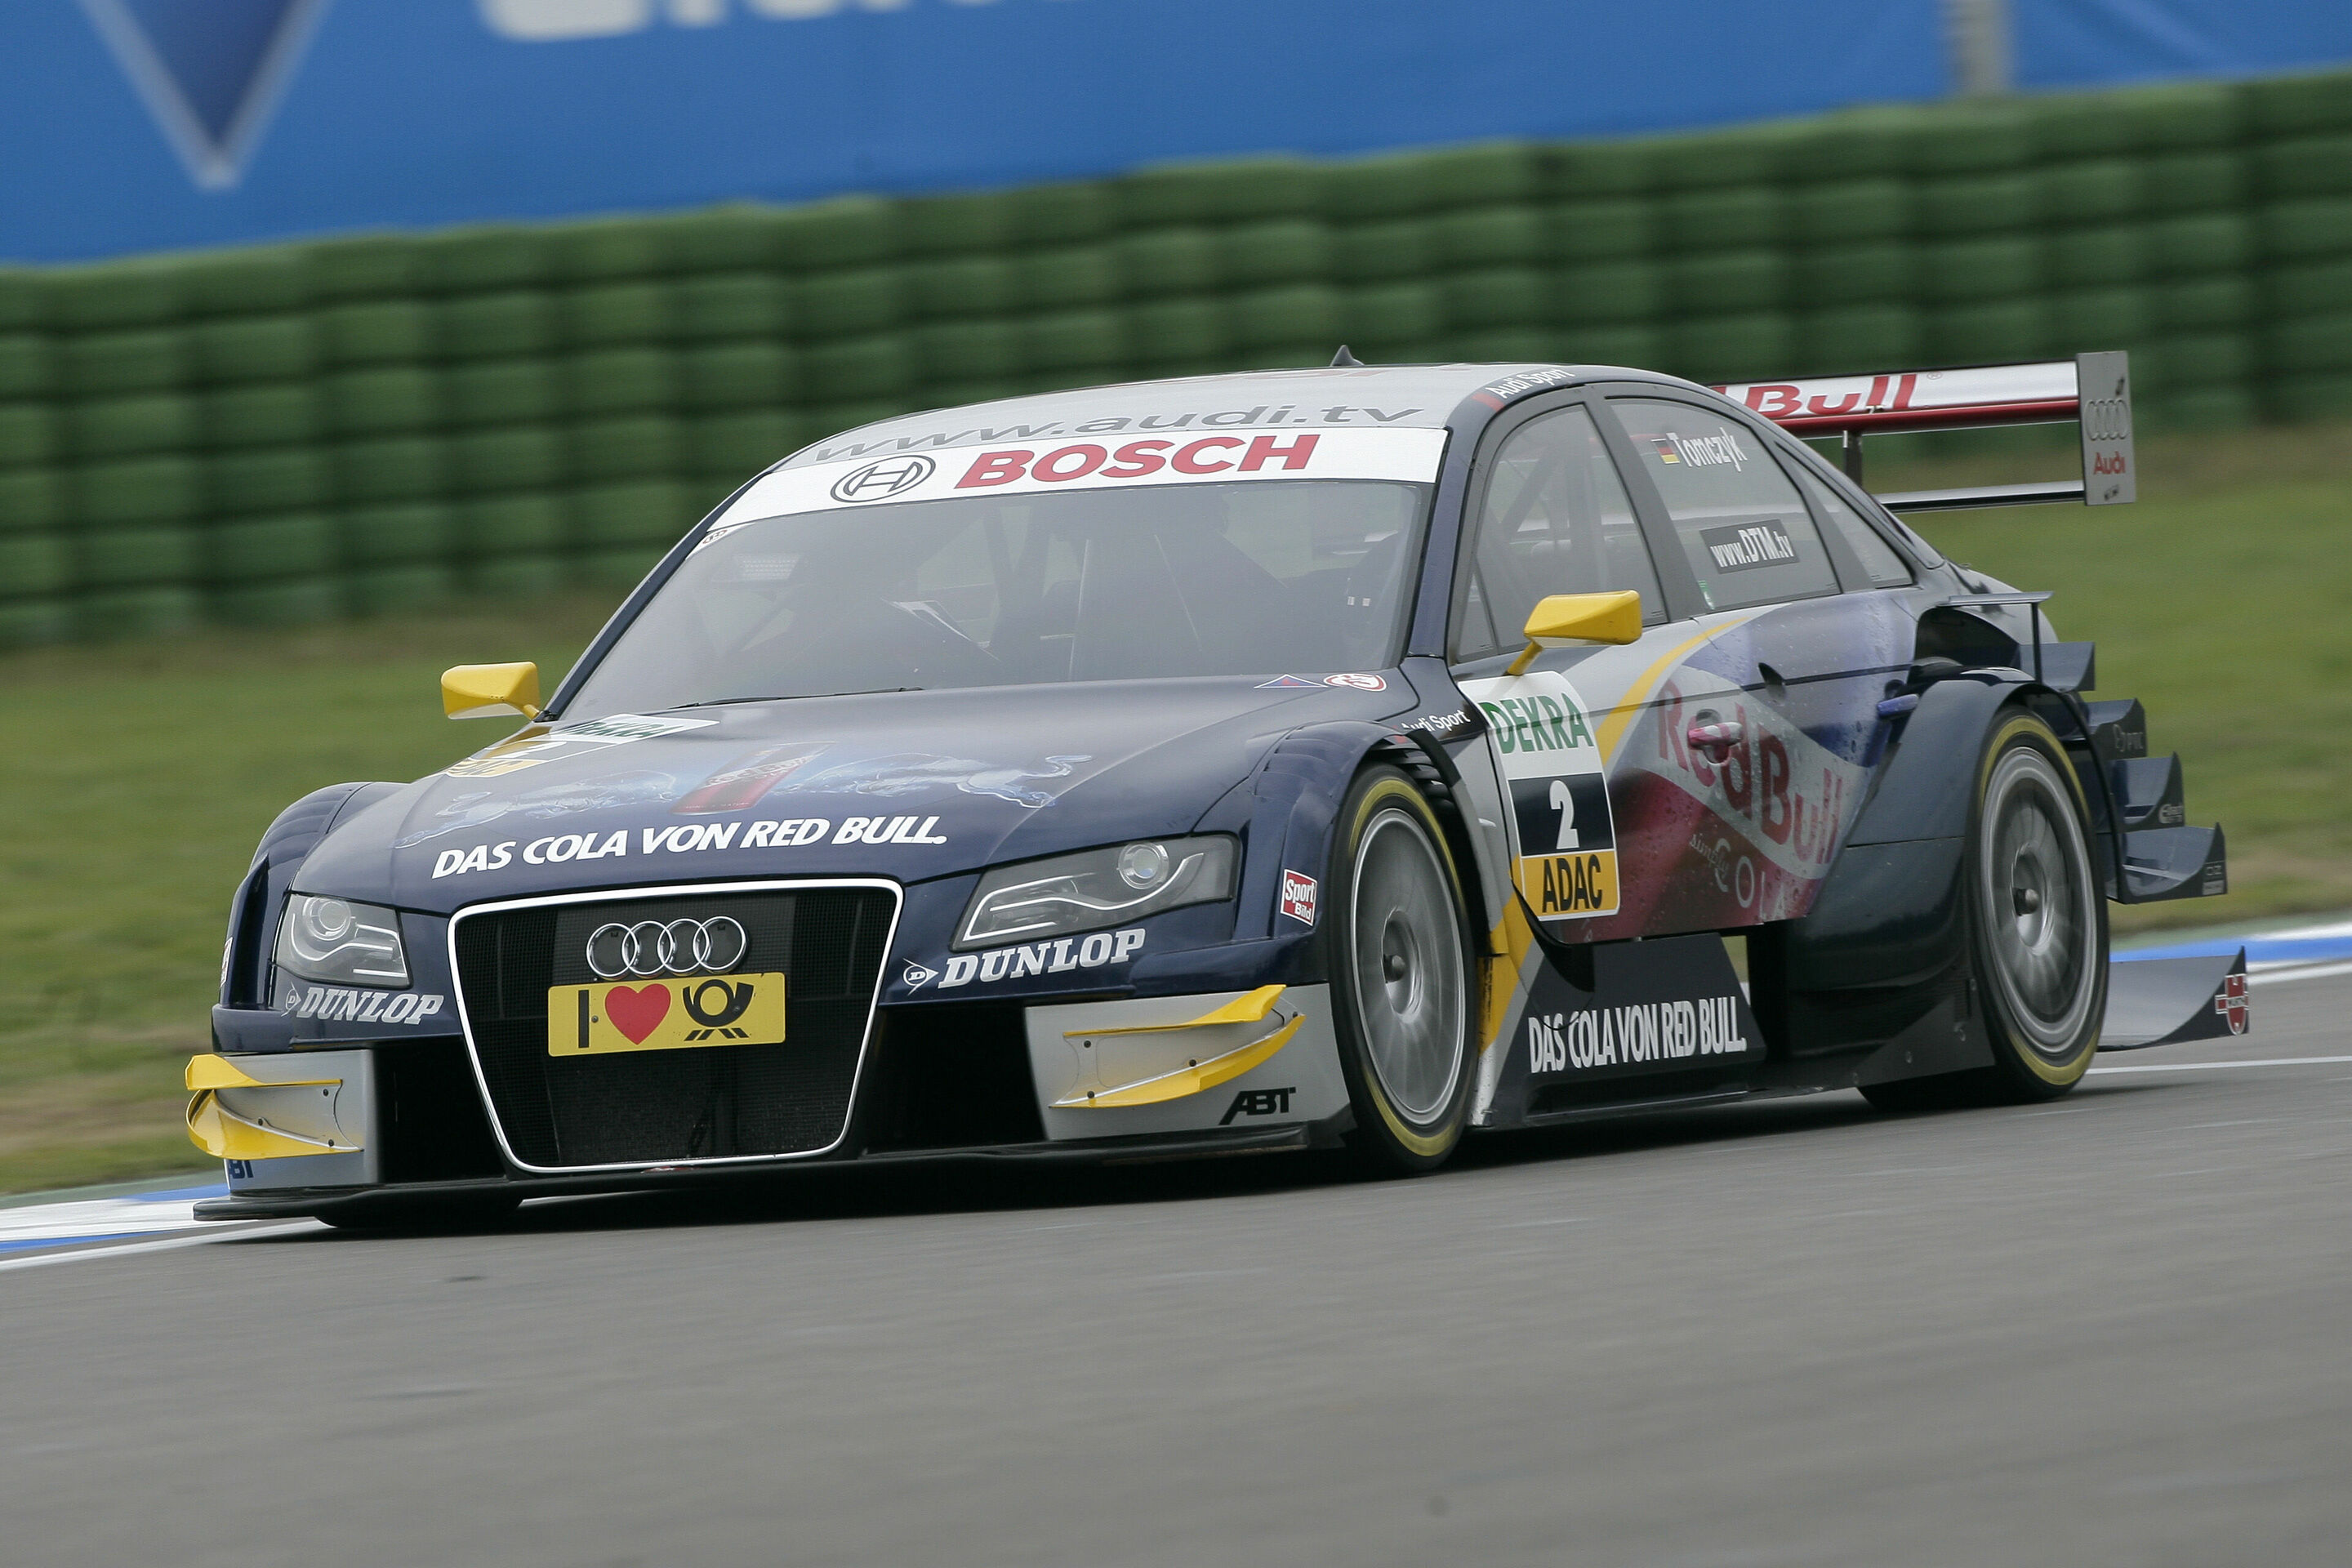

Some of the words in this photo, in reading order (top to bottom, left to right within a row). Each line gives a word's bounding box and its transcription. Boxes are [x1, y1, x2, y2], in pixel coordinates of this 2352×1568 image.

[1485, 377, 1533, 399] Audi
[1517, 368, 1575, 386] Sport
[1744, 373, 1918, 417] Bull
[816, 405, 1424, 461] www.audi.tv
[1665, 427, 1748, 472] Tomczyk
[954, 434, 1321, 490] BOSCH
[2093, 451, 2127, 475] Audi
[1710, 526, 1795, 569] www.DTM.tv
[1429, 709, 1471, 732] Sport
[1477, 693, 1595, 755] DEKRA
[1549, 780, 1580, 850] 2
[430, 843, 515, 880] DAS
[522, 826, 630, 864] COLA
[642, 820, 740, 854] VON
[739, 817, 830, 849] RED
[831, 815, 949, 847] BULL.
[1285, 879, 1315, 904] Sport
[1542, 854, 1603, 914] ADAC
[1294, 902, 1312, 921] Bild
[938, 928, 1147, 989] DUNLOP
[296, 986, 445, 1026] DUNLOP
[577, 989, 590, 1049] I
[1528, 1013, 1566, 1074] DAS
[1567, 1008, 1617, 1070] COLA
[1615, 1003, 1660, 1063] VON
[1660, 1000, 1696, 1059] RED
[1698, 996, 1747, 1056] BULL.
[1218, 1086, 1297, 1126] ABT
